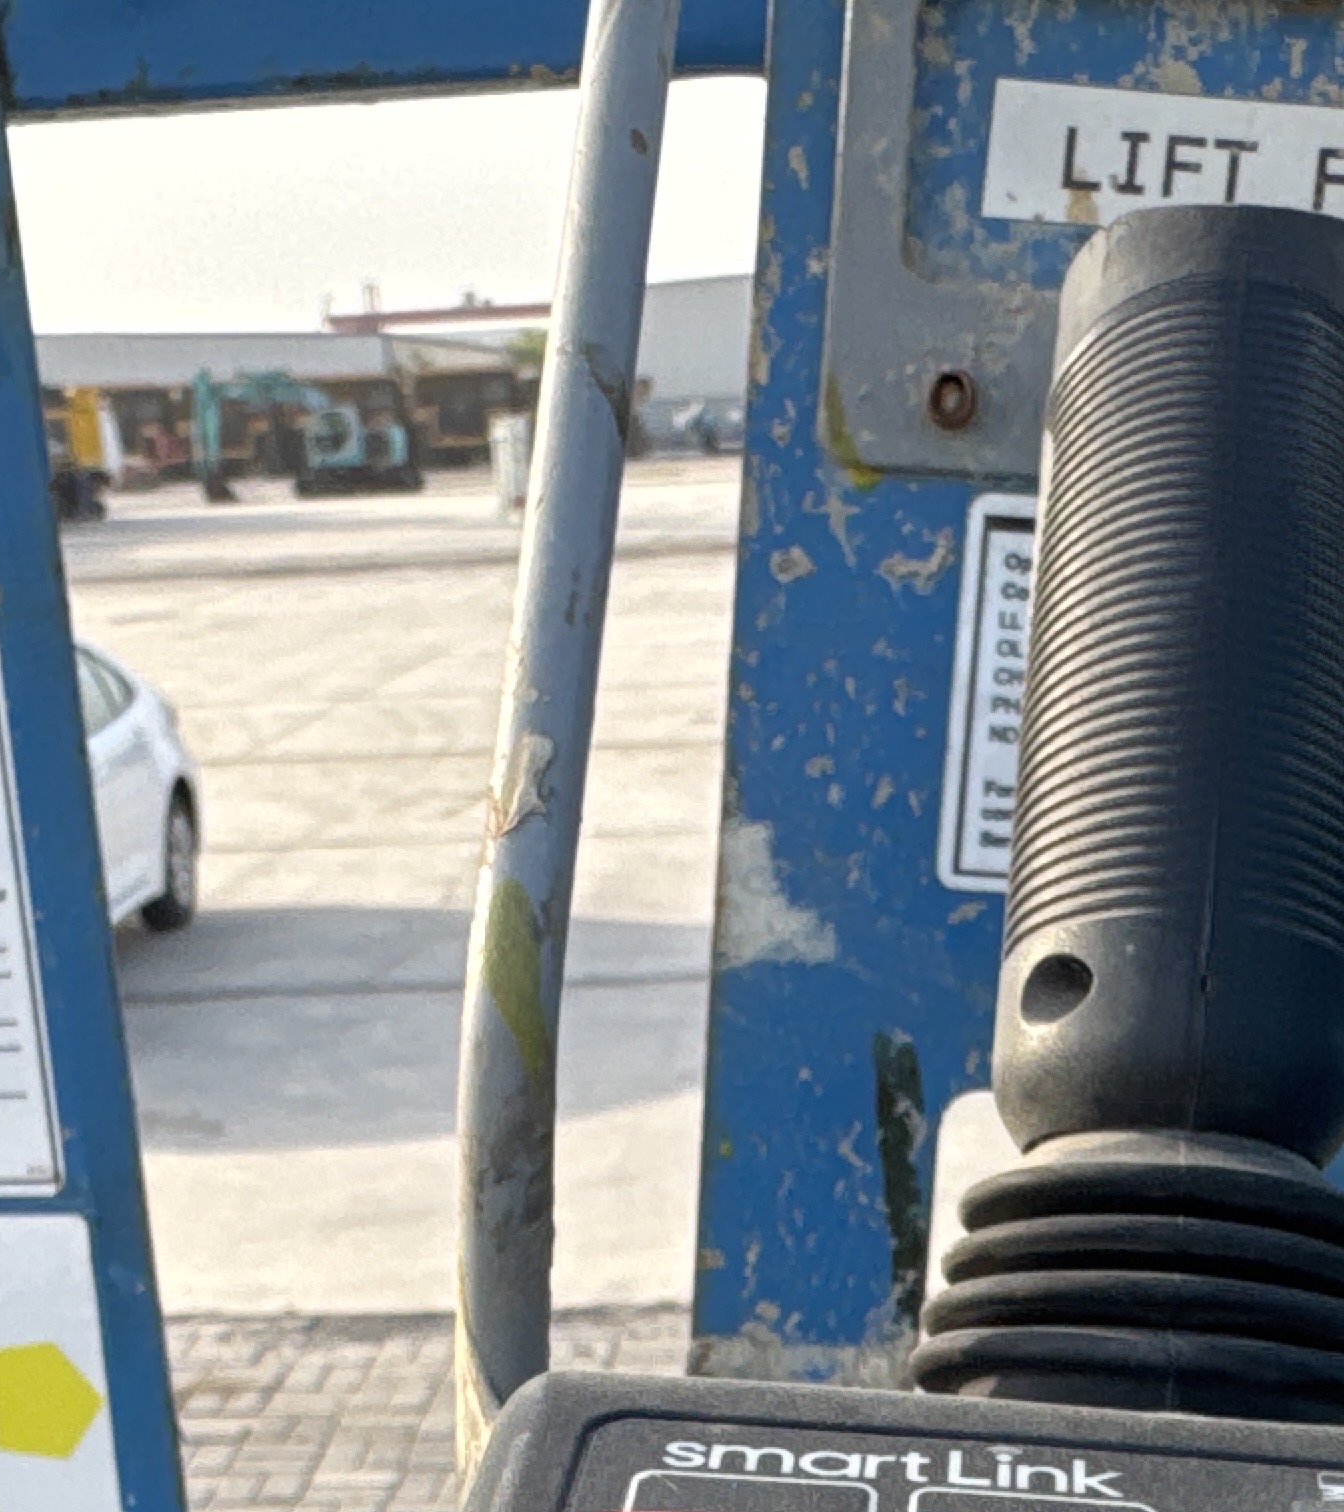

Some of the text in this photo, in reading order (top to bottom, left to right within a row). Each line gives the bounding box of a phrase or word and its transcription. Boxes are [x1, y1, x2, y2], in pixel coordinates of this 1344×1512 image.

[1061, 126, 1259, 204] LIFT
[662, 1440, 1123, 1497] smart Link
